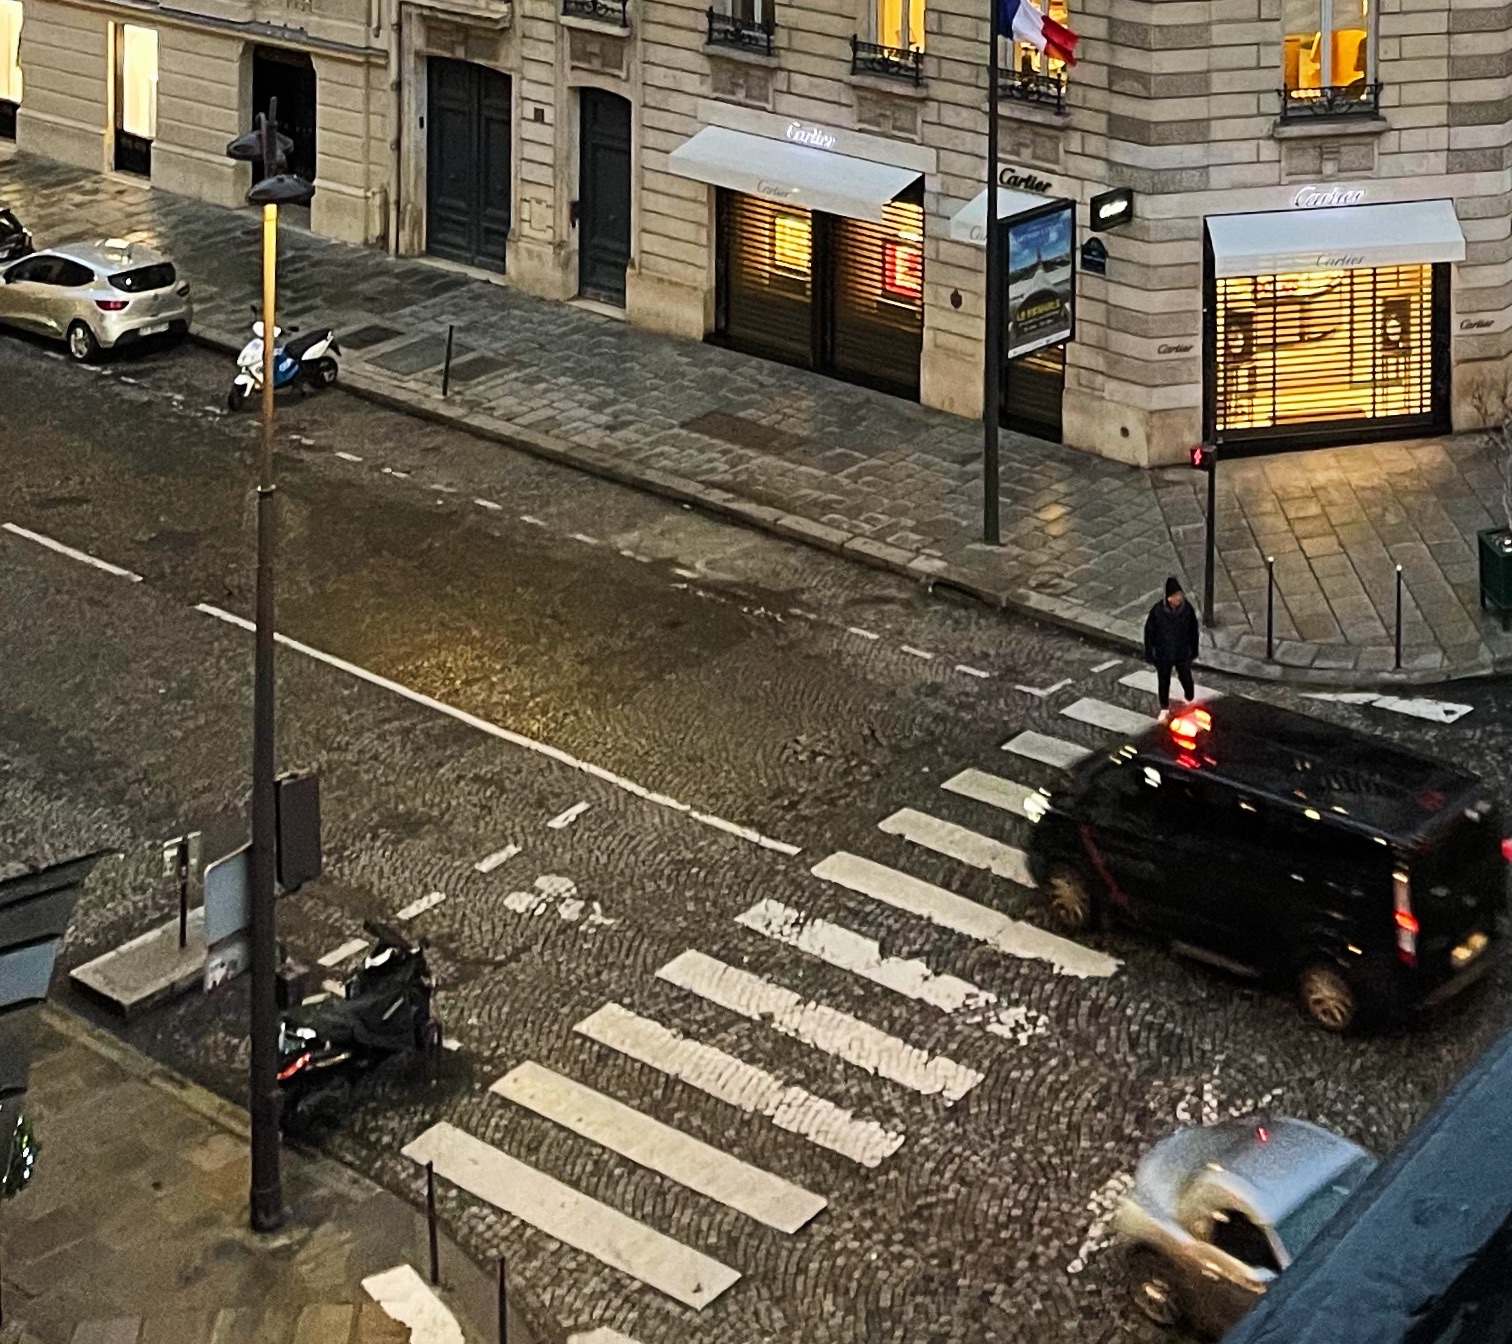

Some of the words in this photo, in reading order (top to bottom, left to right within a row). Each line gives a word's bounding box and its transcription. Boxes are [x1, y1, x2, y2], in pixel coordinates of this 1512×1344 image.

[786, 121, 836, 148] Cartier
[757, 179, 790, 197] Cartier
[998, 167, 1052, 193] Cartier
[1294, 186, 1366, 207] Cartier
[1316, 254, 1366, 267] Cartier
[1460, 318, 1495, 330] Cartier
[1157, 343, 1194, 355] Cartier
